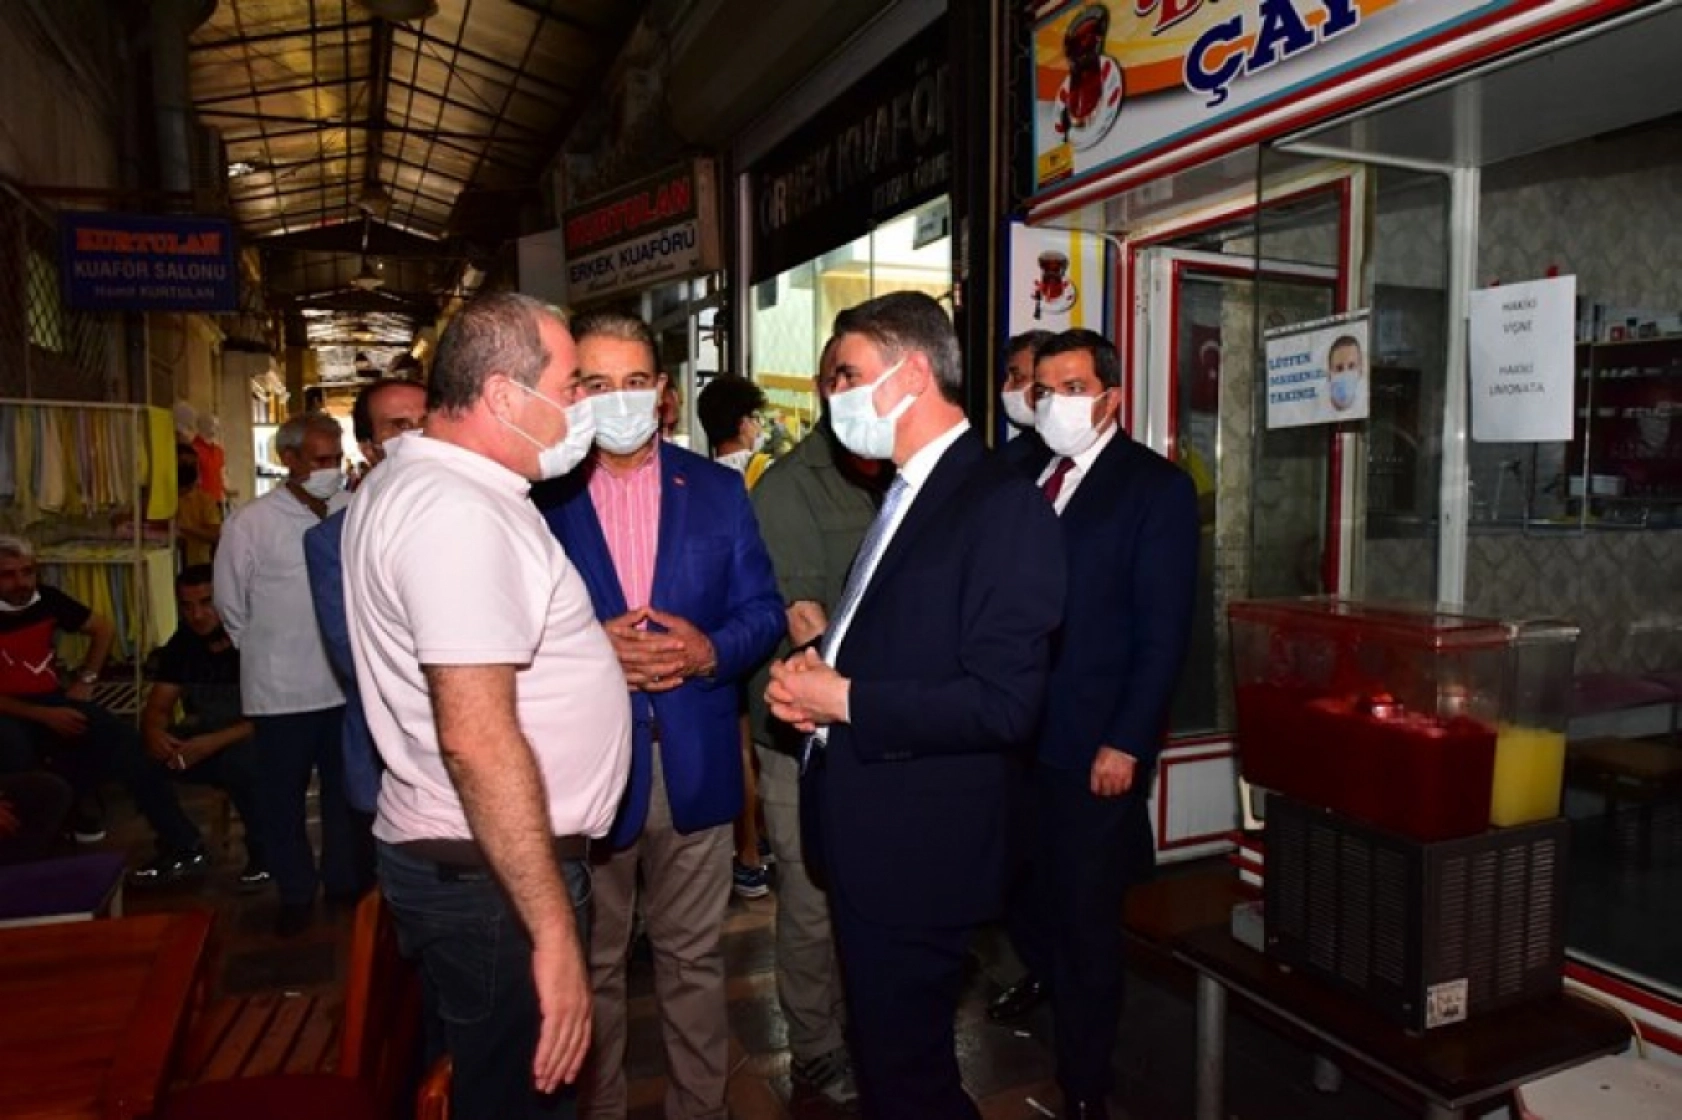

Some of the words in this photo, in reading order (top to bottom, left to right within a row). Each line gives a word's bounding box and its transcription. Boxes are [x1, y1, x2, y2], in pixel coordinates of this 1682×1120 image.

[76, 228, 221, 255] KURTULAN
[570, 254, 615, 282] ERKEK
[619, 225, 695, 268] KUAFÖRÜ
[74, 259, 149, 279] KUAFÖR
[154, 260, 226, 280] SALONU
